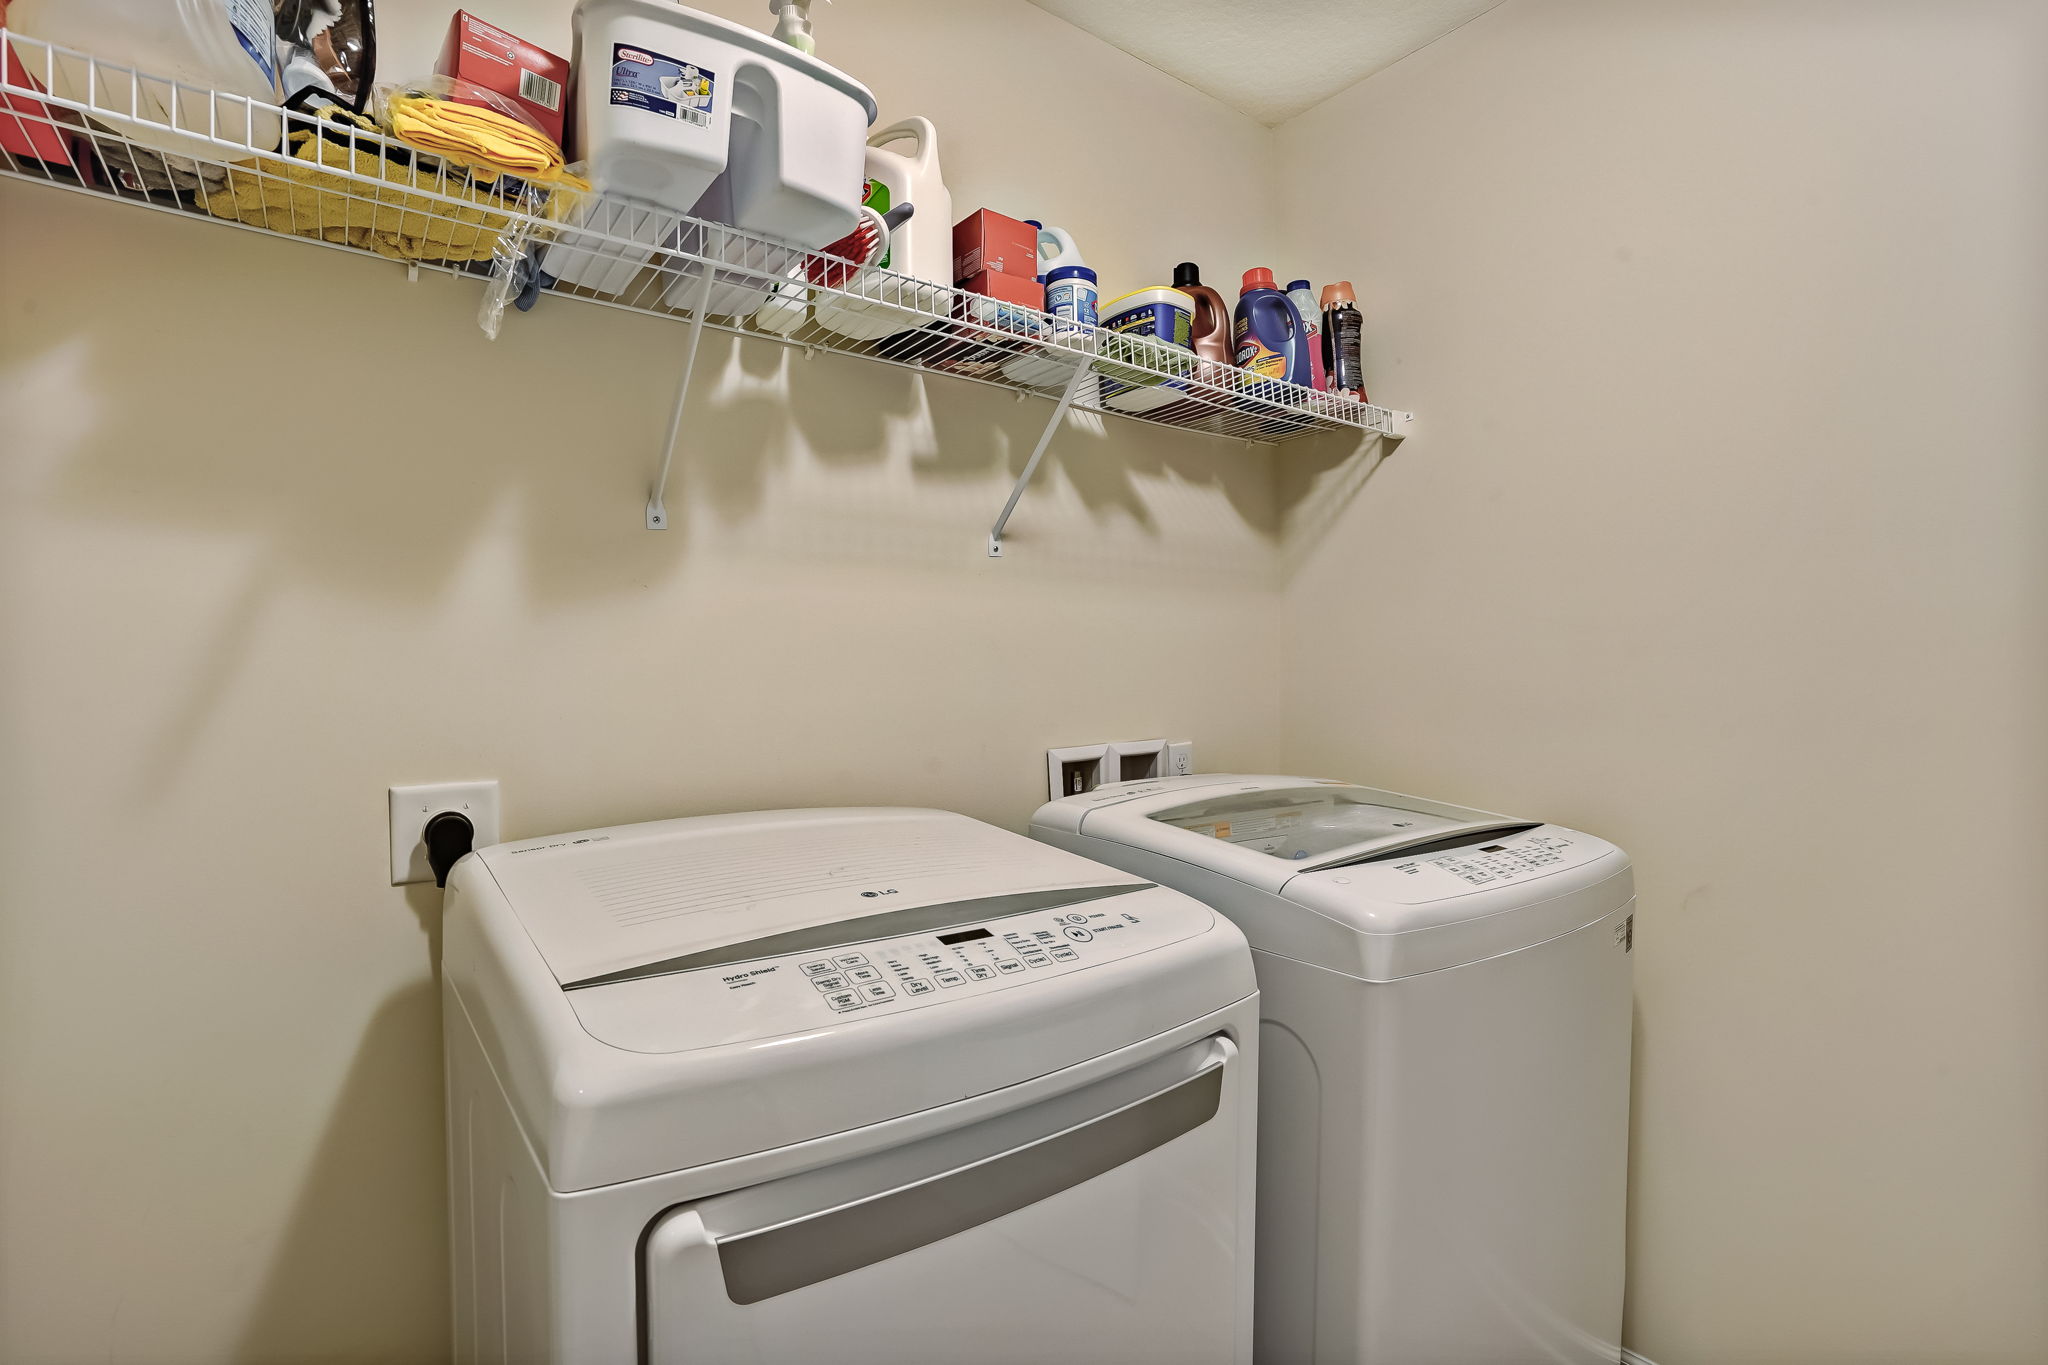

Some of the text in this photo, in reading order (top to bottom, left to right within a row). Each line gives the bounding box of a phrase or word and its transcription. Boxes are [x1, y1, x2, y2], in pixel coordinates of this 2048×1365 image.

[621, 50, 652, 63] Sterilite
[615, 66, 639, 78] Ultra
[1000, 962, 1018, 970] Signal
[722, 973, 749, 982] Hydro
[912, 985, 930, 994] Level
[831, 993, 853, 1001] Custom
